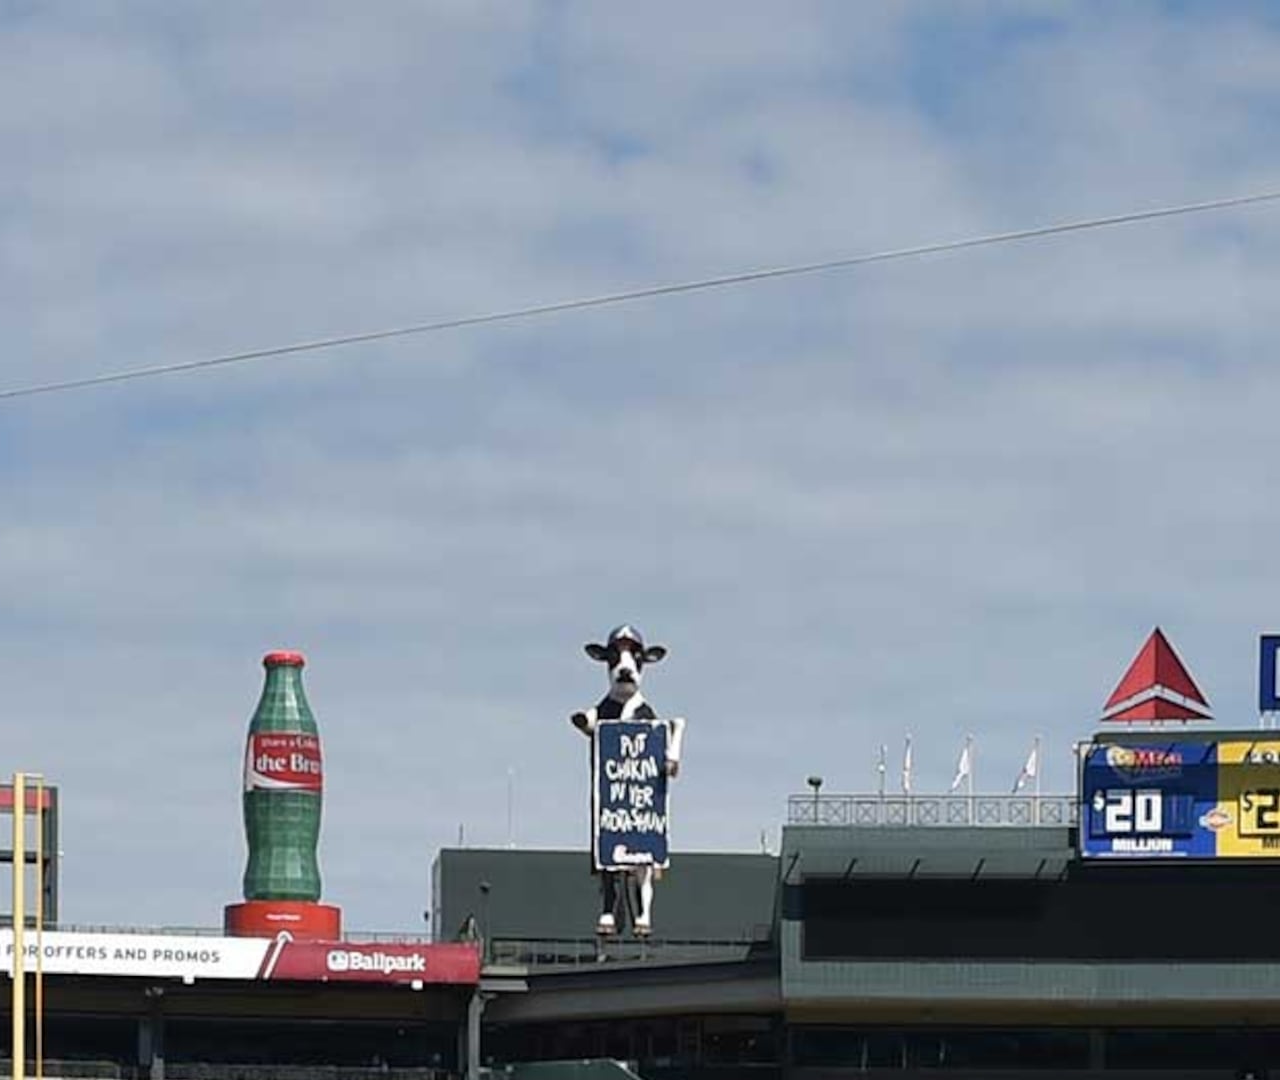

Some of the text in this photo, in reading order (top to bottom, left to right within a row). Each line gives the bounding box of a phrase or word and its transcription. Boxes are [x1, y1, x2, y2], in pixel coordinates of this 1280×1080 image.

[621, 733, 647, 757] PUT
[256, 753, 287, 773] the
[609, 781, 655, 809] IN YER
[1093, 789, 1163, 833] $20
[1111, 836, 1173, 852] MILLION
[43, 945, 107, 961] OFFERS
[113, 947, 147, 961] AND
[152, 949, 221, 963] PROMOS
[349, 951, 426, 974] Ballpark
